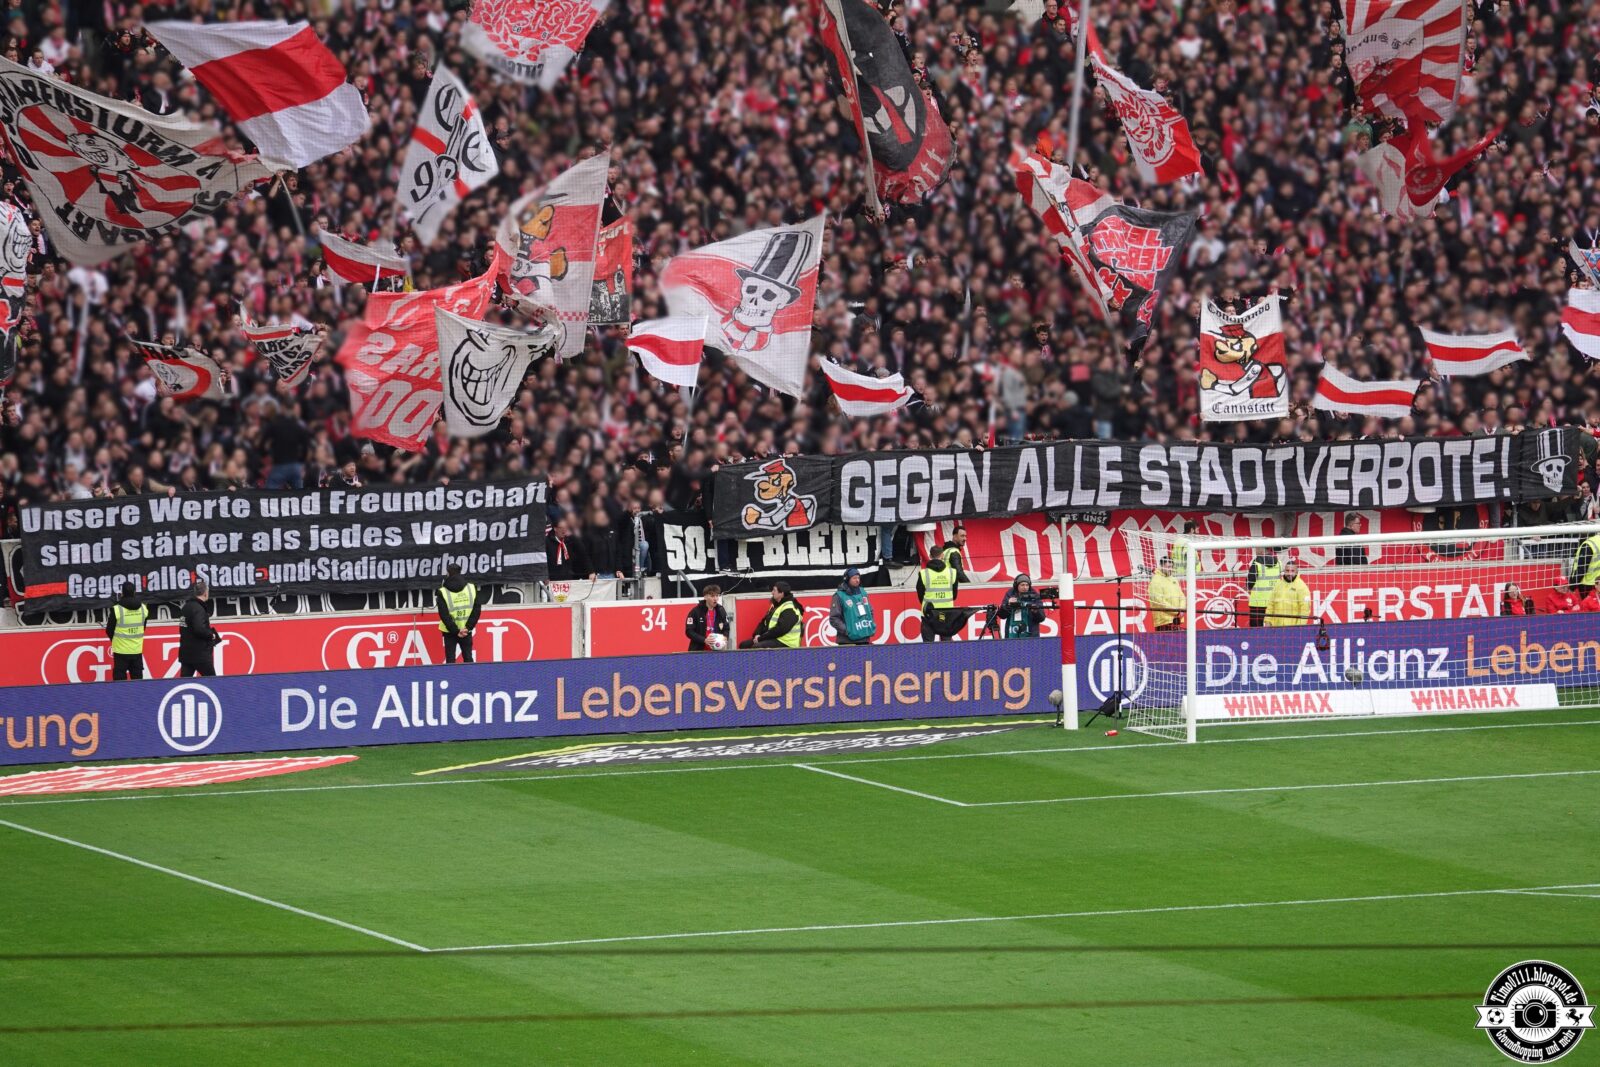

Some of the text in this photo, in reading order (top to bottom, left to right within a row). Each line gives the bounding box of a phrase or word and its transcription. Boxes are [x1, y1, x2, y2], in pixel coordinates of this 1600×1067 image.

[1211, 401, 1276, 415] Cannstatt
[840, 435, 1512, 524] GEGEN ALLE STADTVERBOTE!
[21, 481, 547, 533] Unsere Werte und Freundschaft
[40, 514, 529, 567] sind stärker als jedes Verbot!
[68, 572, 143, 599] Gegen
[147, 565, 191, 592] alle
[641, 607, 668, 632] 34
[1205, 630, 1600, 688] Die Allianz Leben
[281, 660, 1031, 733] Die Allianz Lebensversicherung
[1223, 692, 1335, 717] WINAMAX
[1411, 687, 1520, 711] WINAMAX
[0, 712, 99, 757] ung
